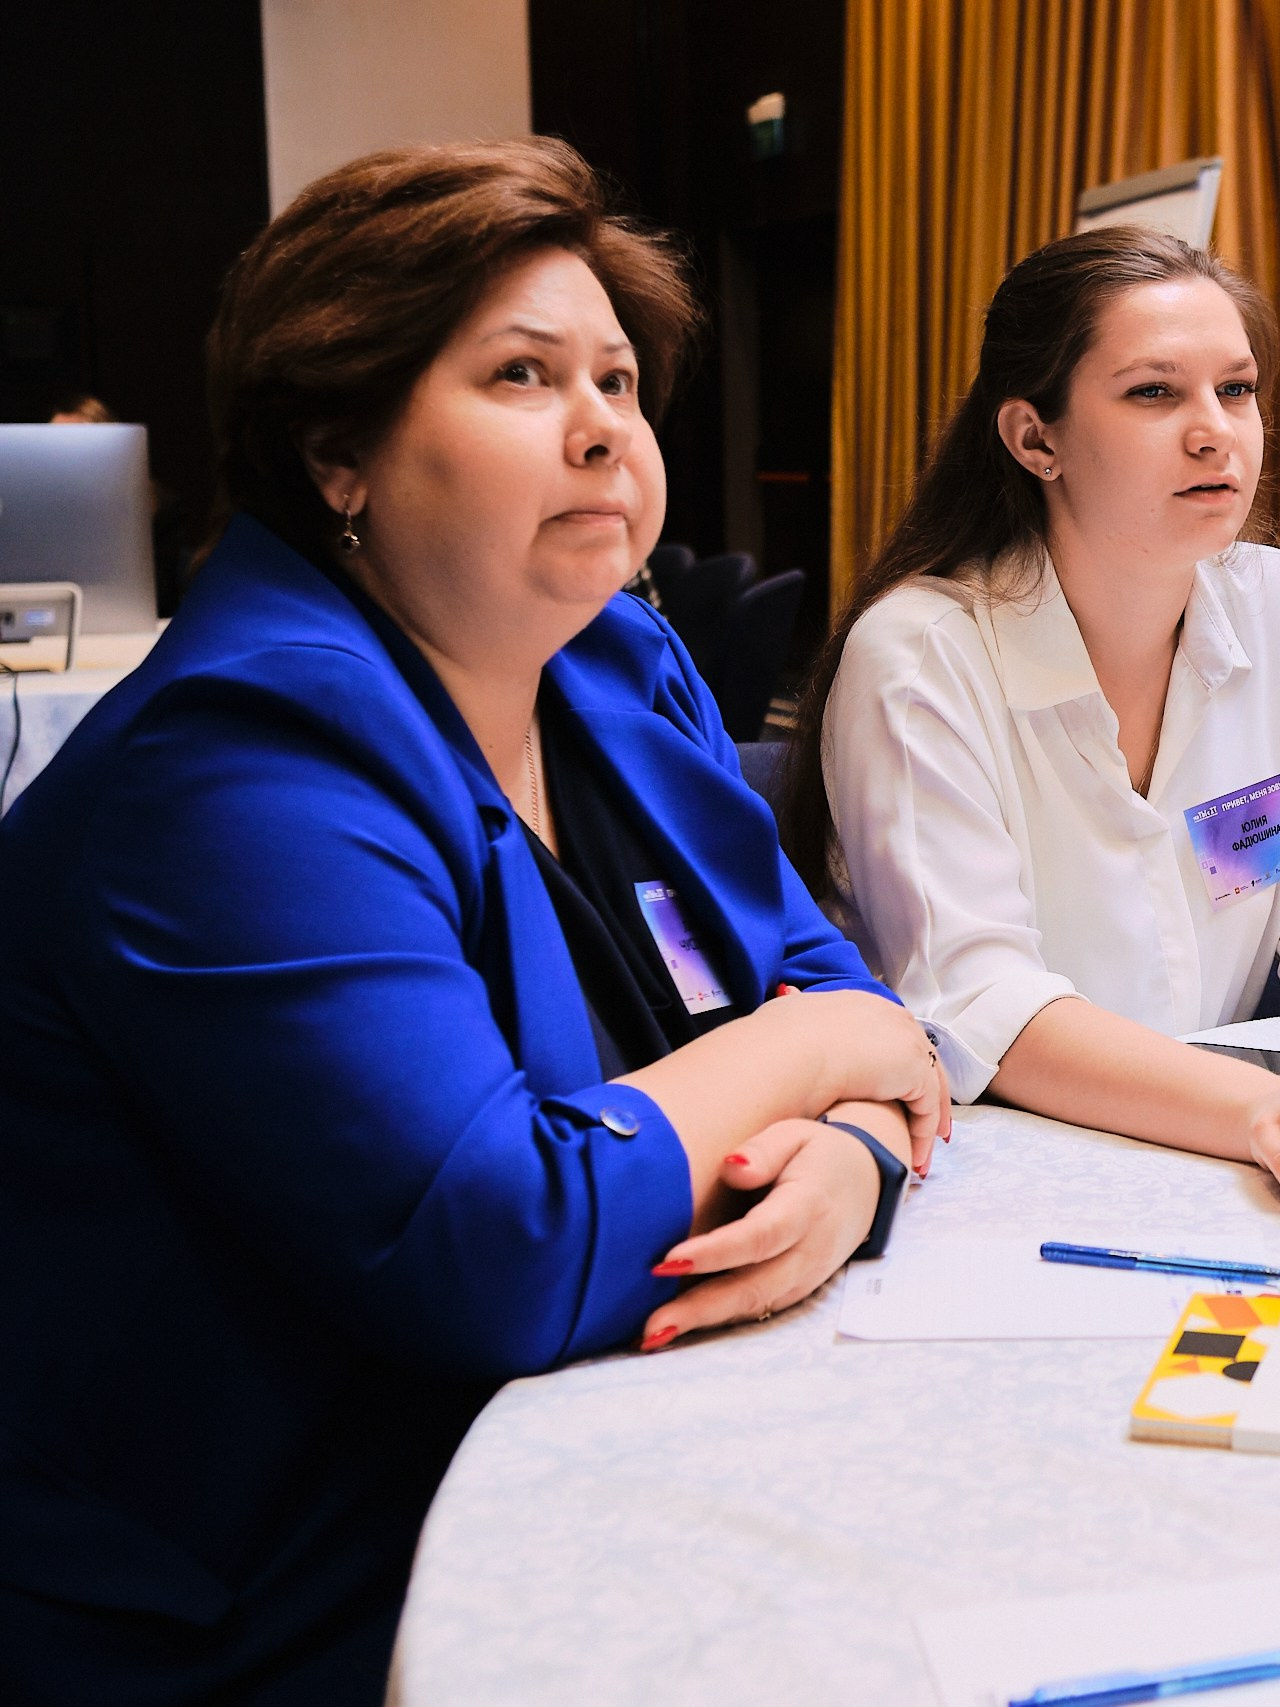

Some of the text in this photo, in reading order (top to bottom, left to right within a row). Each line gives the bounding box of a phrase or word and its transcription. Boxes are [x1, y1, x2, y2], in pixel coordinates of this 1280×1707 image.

[1221, 794, 1250, 812] ПРИВЕТ,
[1249, 787, 1268, 802] МЕНЯ
[1241, 814, 1268, 834] ЮЛИЯ
